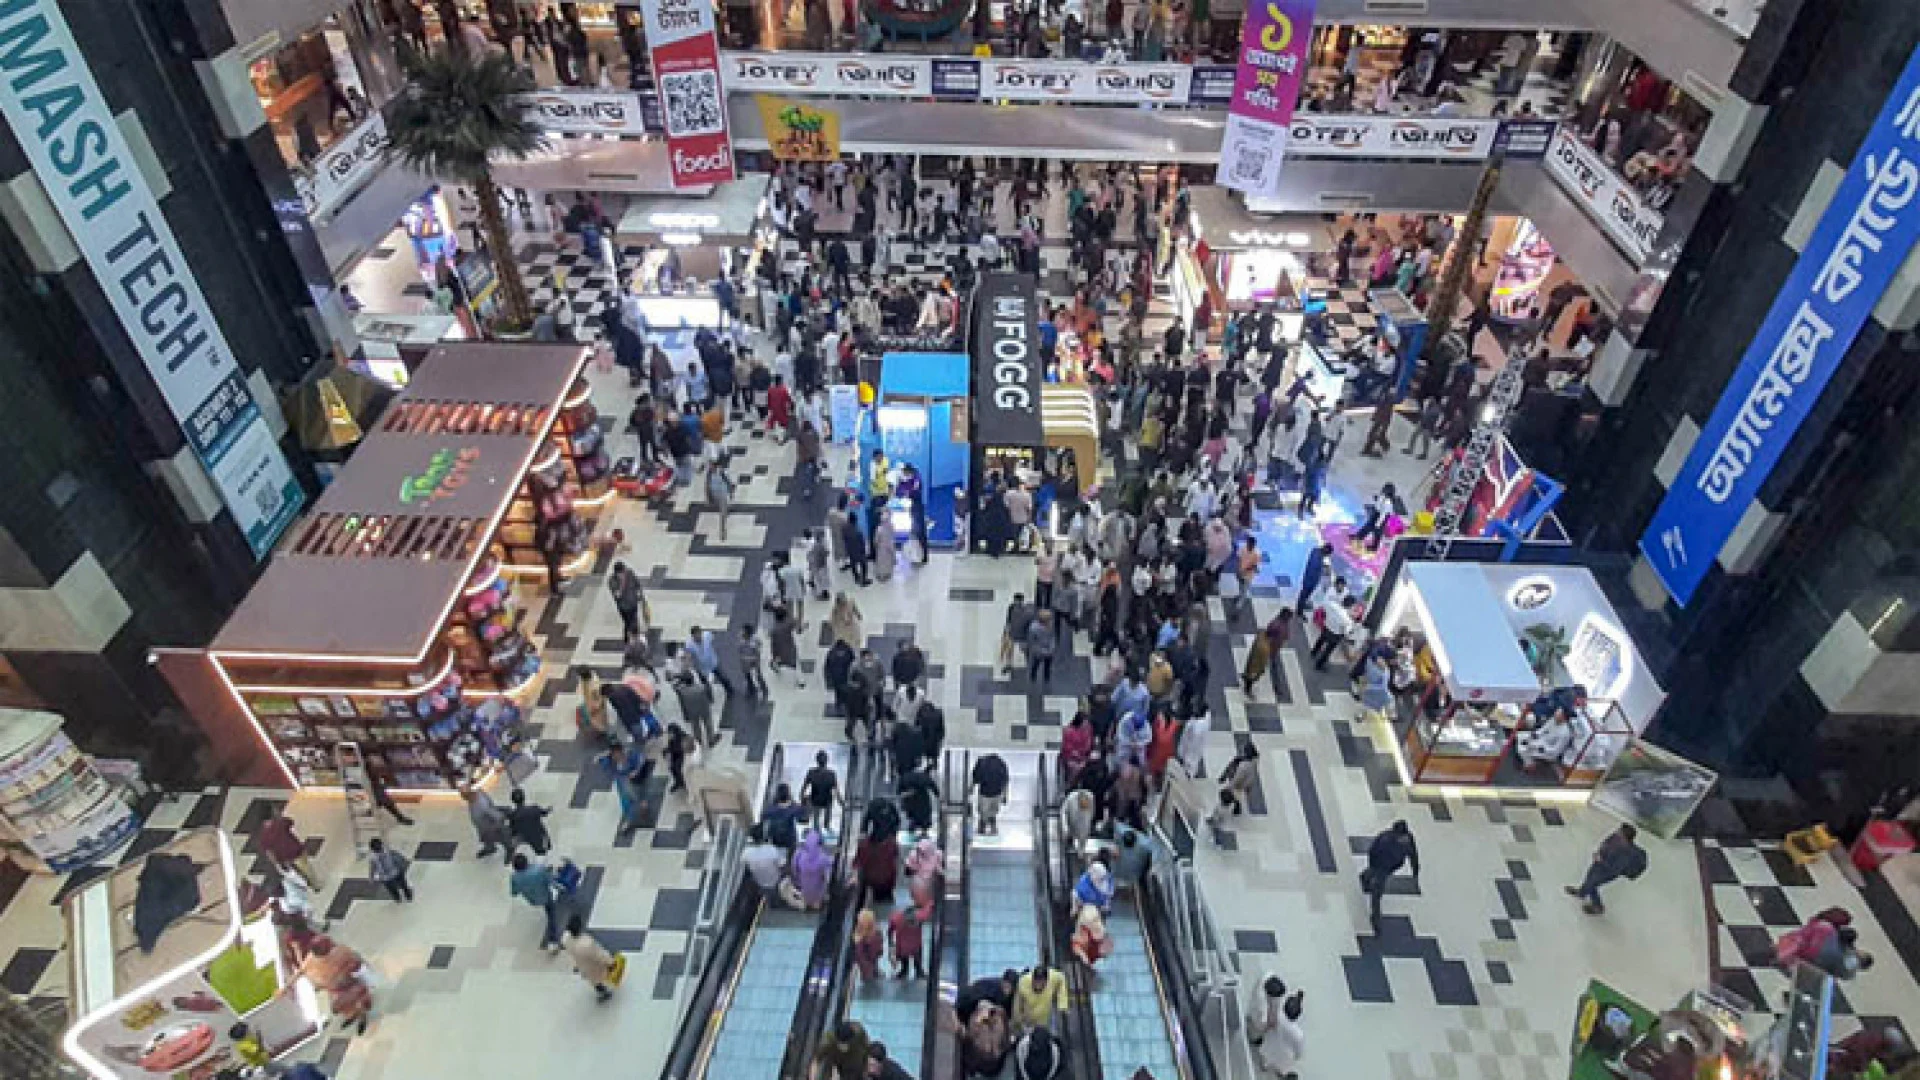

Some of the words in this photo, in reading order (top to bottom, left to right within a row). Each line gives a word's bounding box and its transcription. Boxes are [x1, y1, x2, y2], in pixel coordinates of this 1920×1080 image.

[1261, 3, 1293, 51] ১
[736, 60, 818, 83] JOTEY
[995, 68, 1076, 91] JOTEY
[1291, 125, 1371, 146] OTEY
[105, 210, 208, 374] TECH
[993, 320, 1030, 411] FOGG
